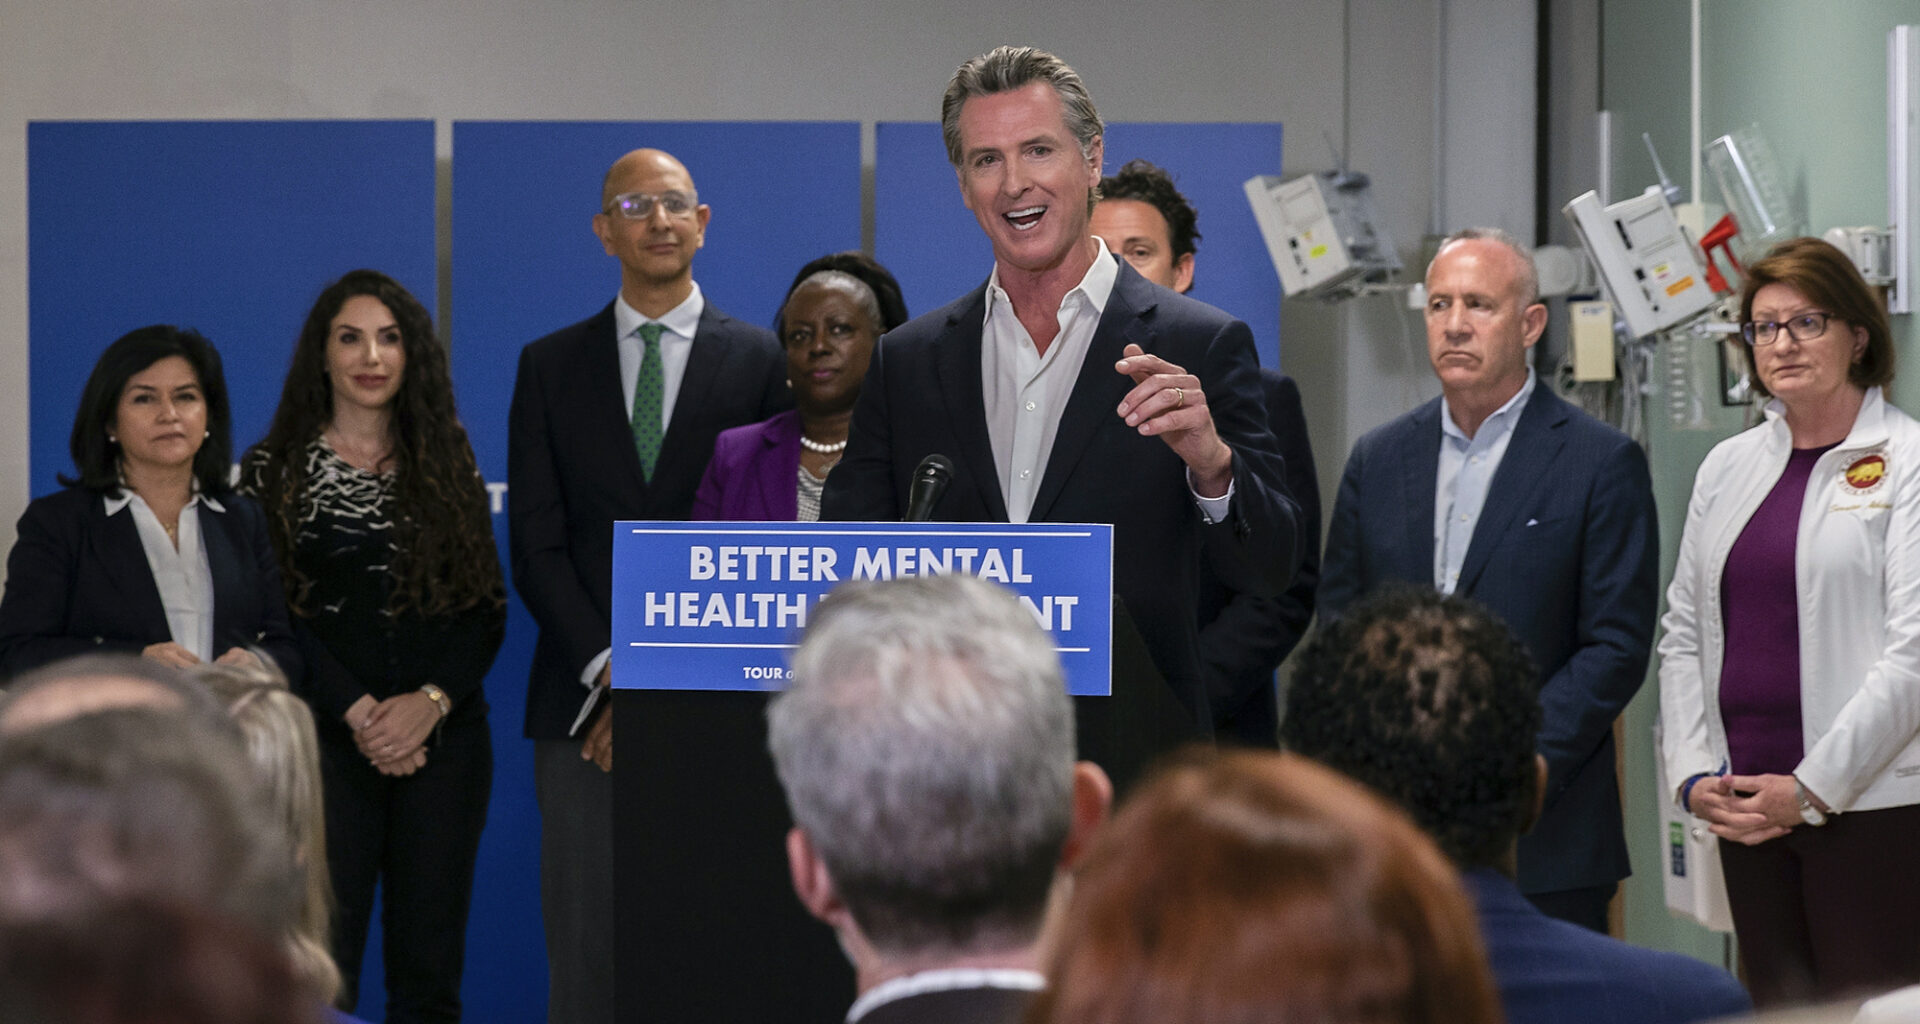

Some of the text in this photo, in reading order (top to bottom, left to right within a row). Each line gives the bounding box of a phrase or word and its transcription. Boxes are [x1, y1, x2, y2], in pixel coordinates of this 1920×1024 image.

[691, 546, 1032, 583] BETTER MENTAL
[645, 592, 807, 628] HEALTH
[743, 666, 783, 679] TOUR
